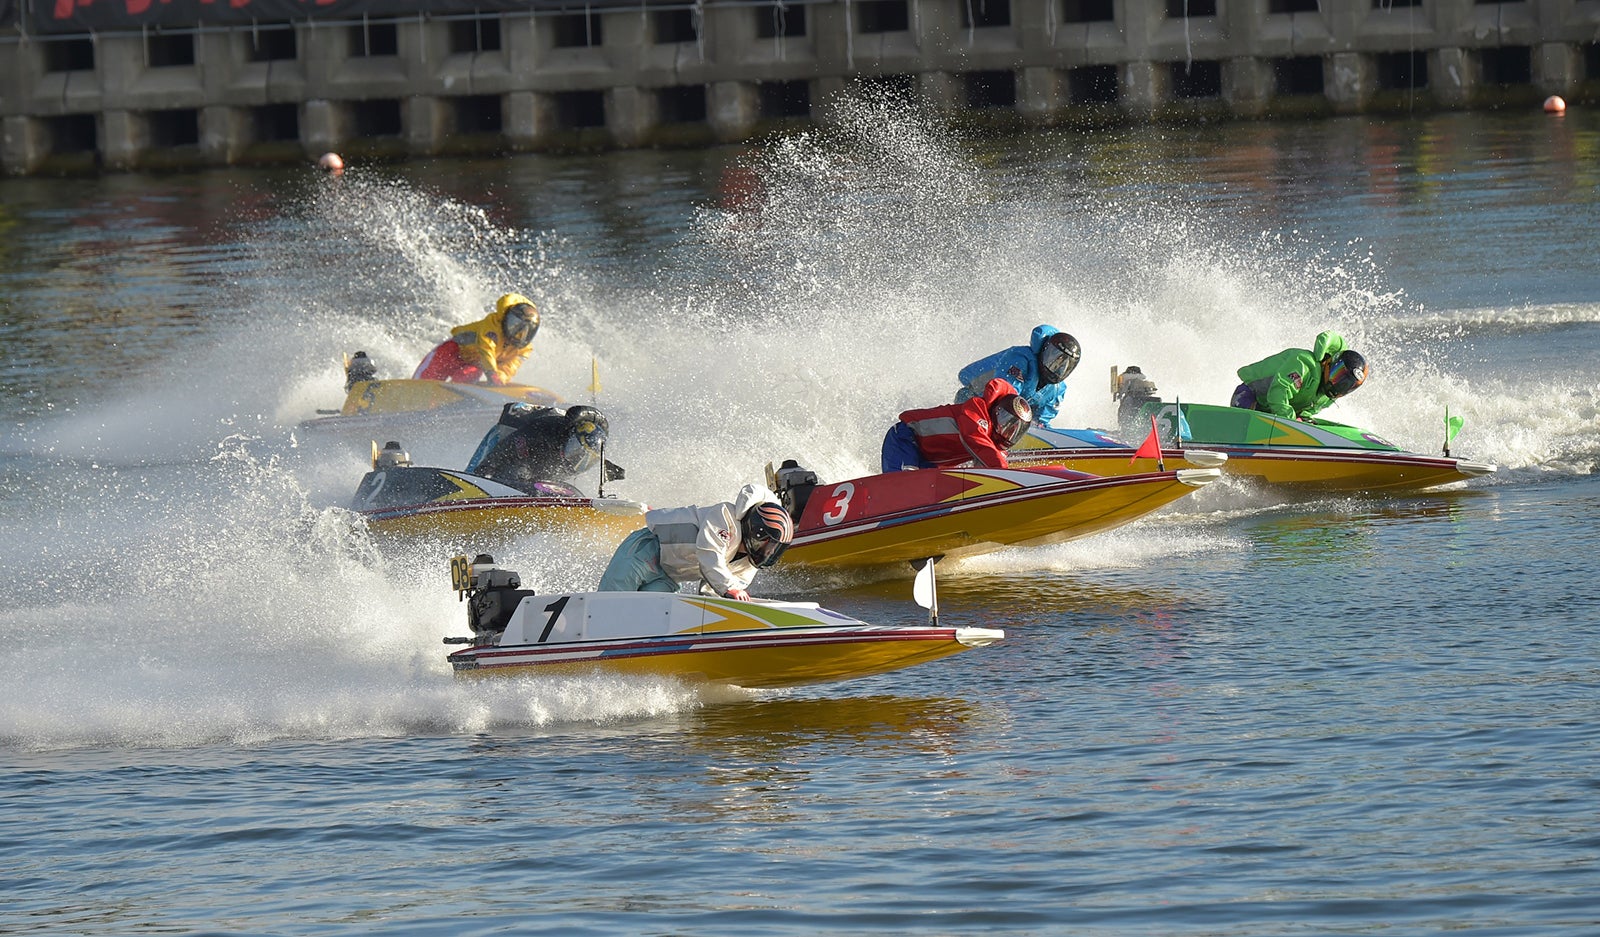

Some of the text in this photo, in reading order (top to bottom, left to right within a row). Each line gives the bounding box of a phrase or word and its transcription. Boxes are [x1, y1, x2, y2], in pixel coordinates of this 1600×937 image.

[356, 382, 381, 415] 5
[1154, 404, 1177, 442] 6
[361, 471, 387, 509] 2
[823, 482, 855, 526] 3
[537, 596, 571, 643] 1
